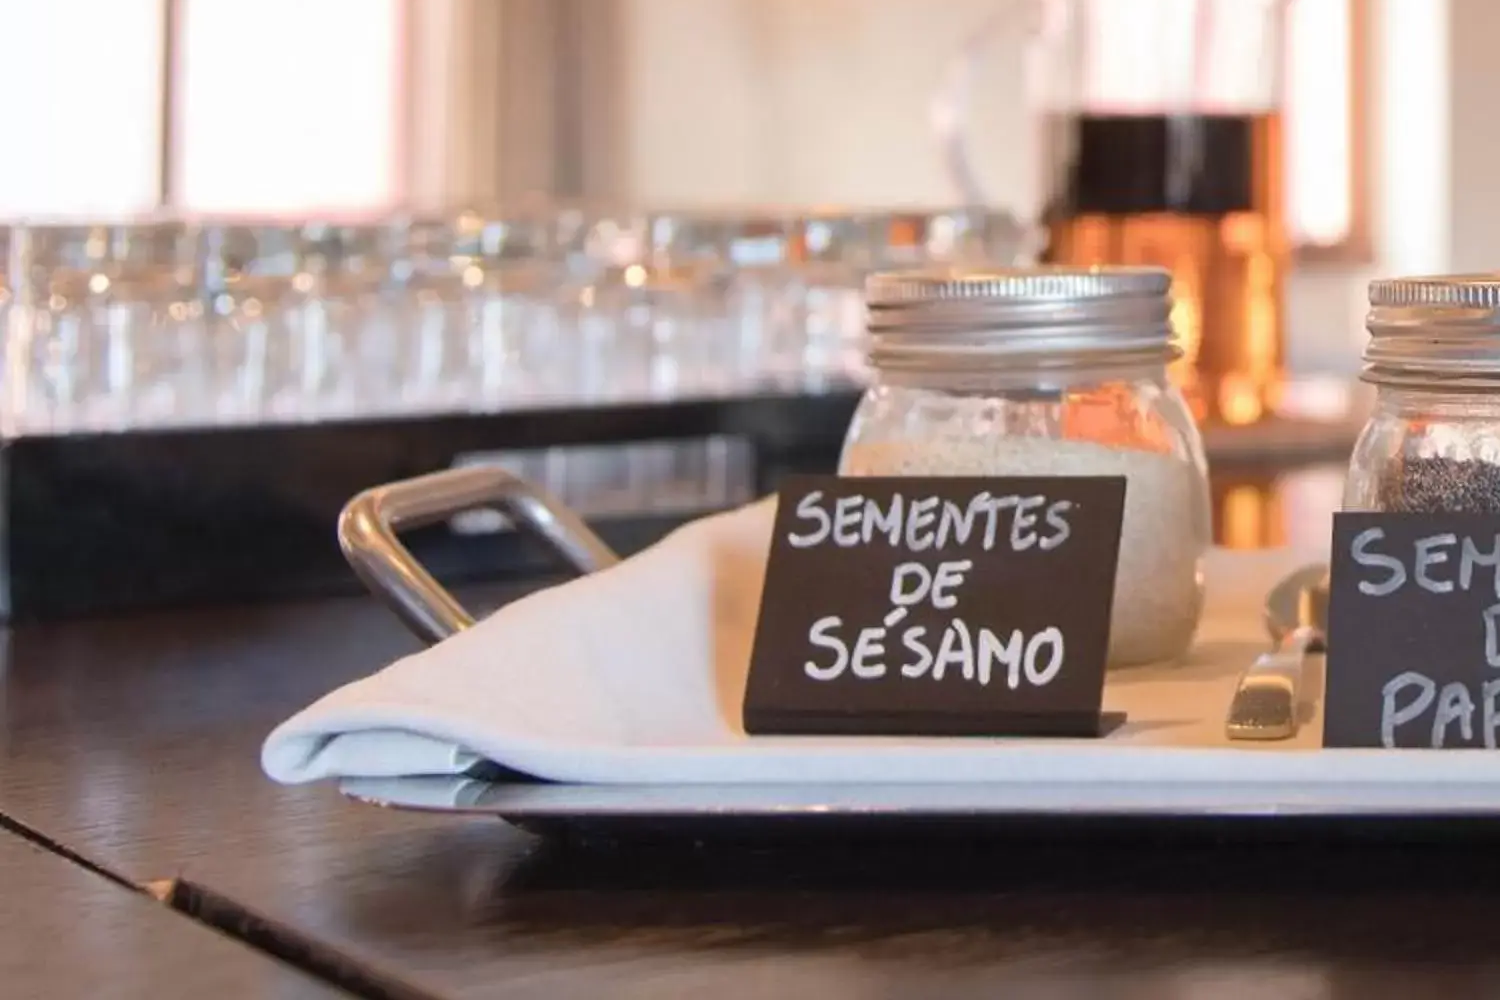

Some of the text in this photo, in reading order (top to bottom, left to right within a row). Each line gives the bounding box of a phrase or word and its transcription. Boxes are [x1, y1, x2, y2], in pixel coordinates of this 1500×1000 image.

[787, 490, 1072, 551] SEMENTES
[889, 559, 972, 608] DE
[803, 606, 1064, 689] SÉSAMO
